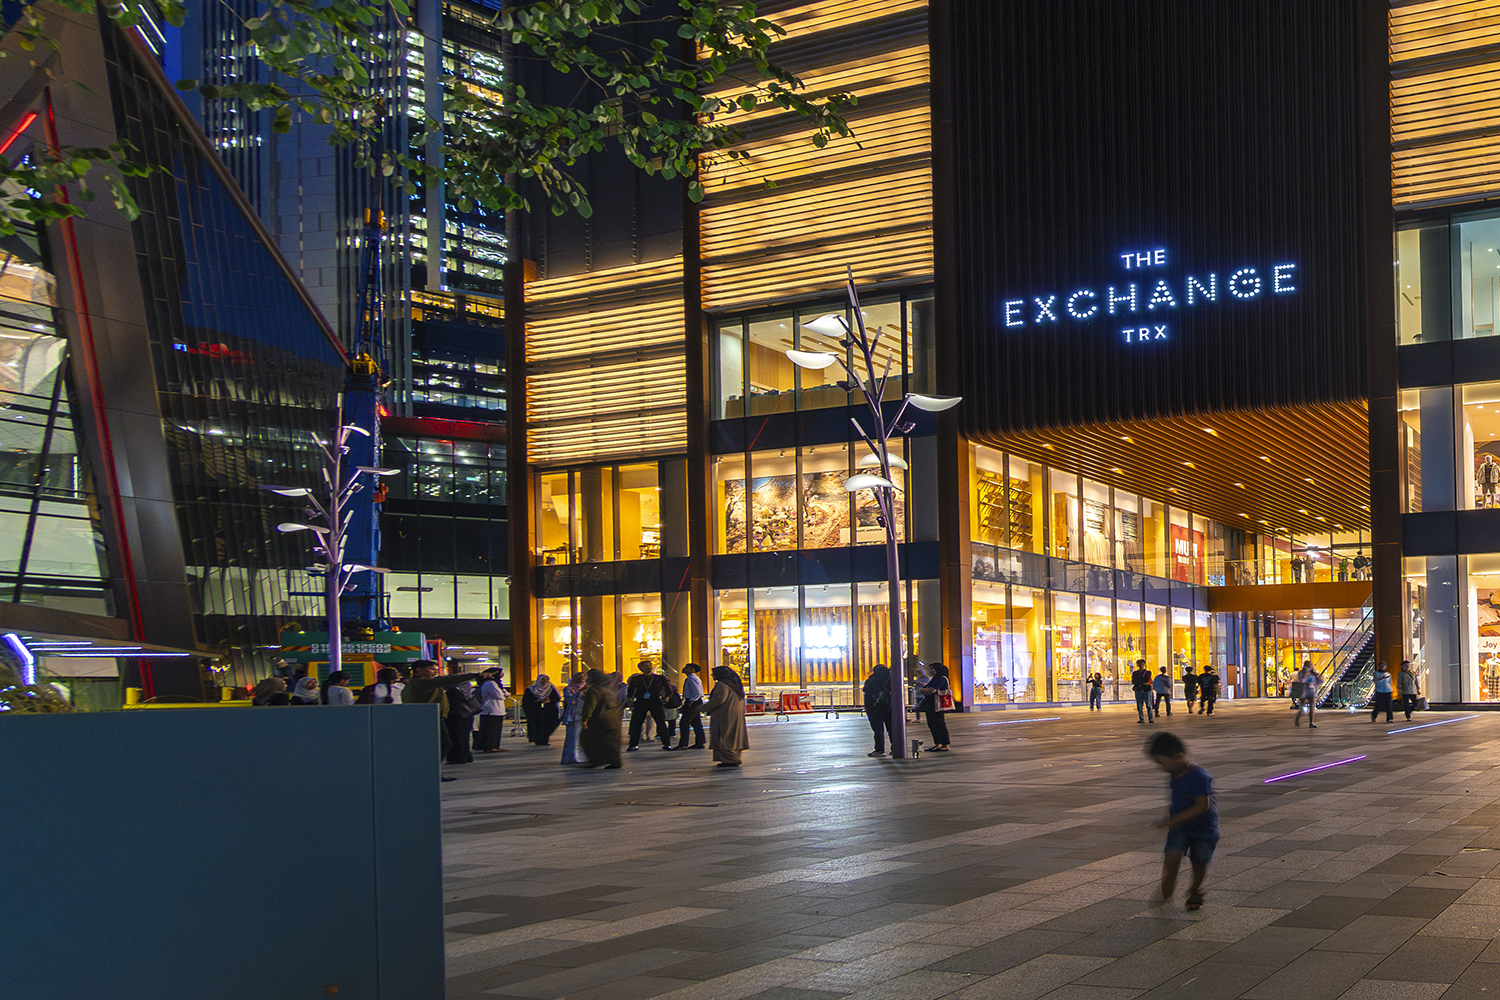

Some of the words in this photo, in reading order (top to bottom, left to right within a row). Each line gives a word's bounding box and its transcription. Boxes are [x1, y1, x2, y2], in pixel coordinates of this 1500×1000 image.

[1121, 249, 1166, 269] THE
[1004, 263, 1296, 327] EXCHANGE
[1122, 325, 1167, 343] TRX
[1174, 538, 1198, 559] MUI
[1482, 641, 1498, 650] Joy
